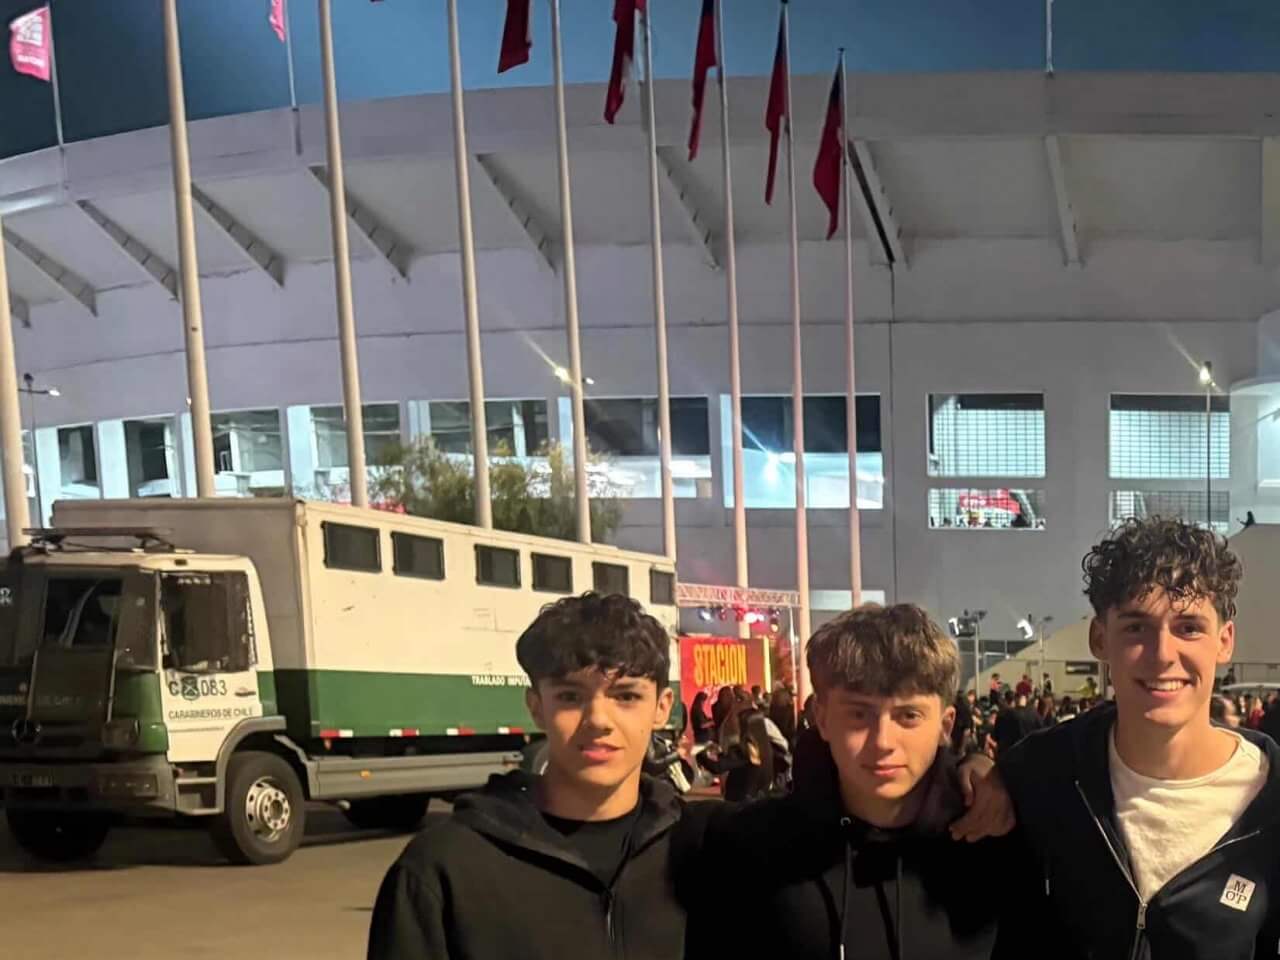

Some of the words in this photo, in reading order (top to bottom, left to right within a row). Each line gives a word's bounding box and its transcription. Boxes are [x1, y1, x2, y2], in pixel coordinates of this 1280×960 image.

[168, 708, 221, 720] CARABINEROS
[222, 707, 232, 718] DE
[233, 706, 254, 718] CHILE
